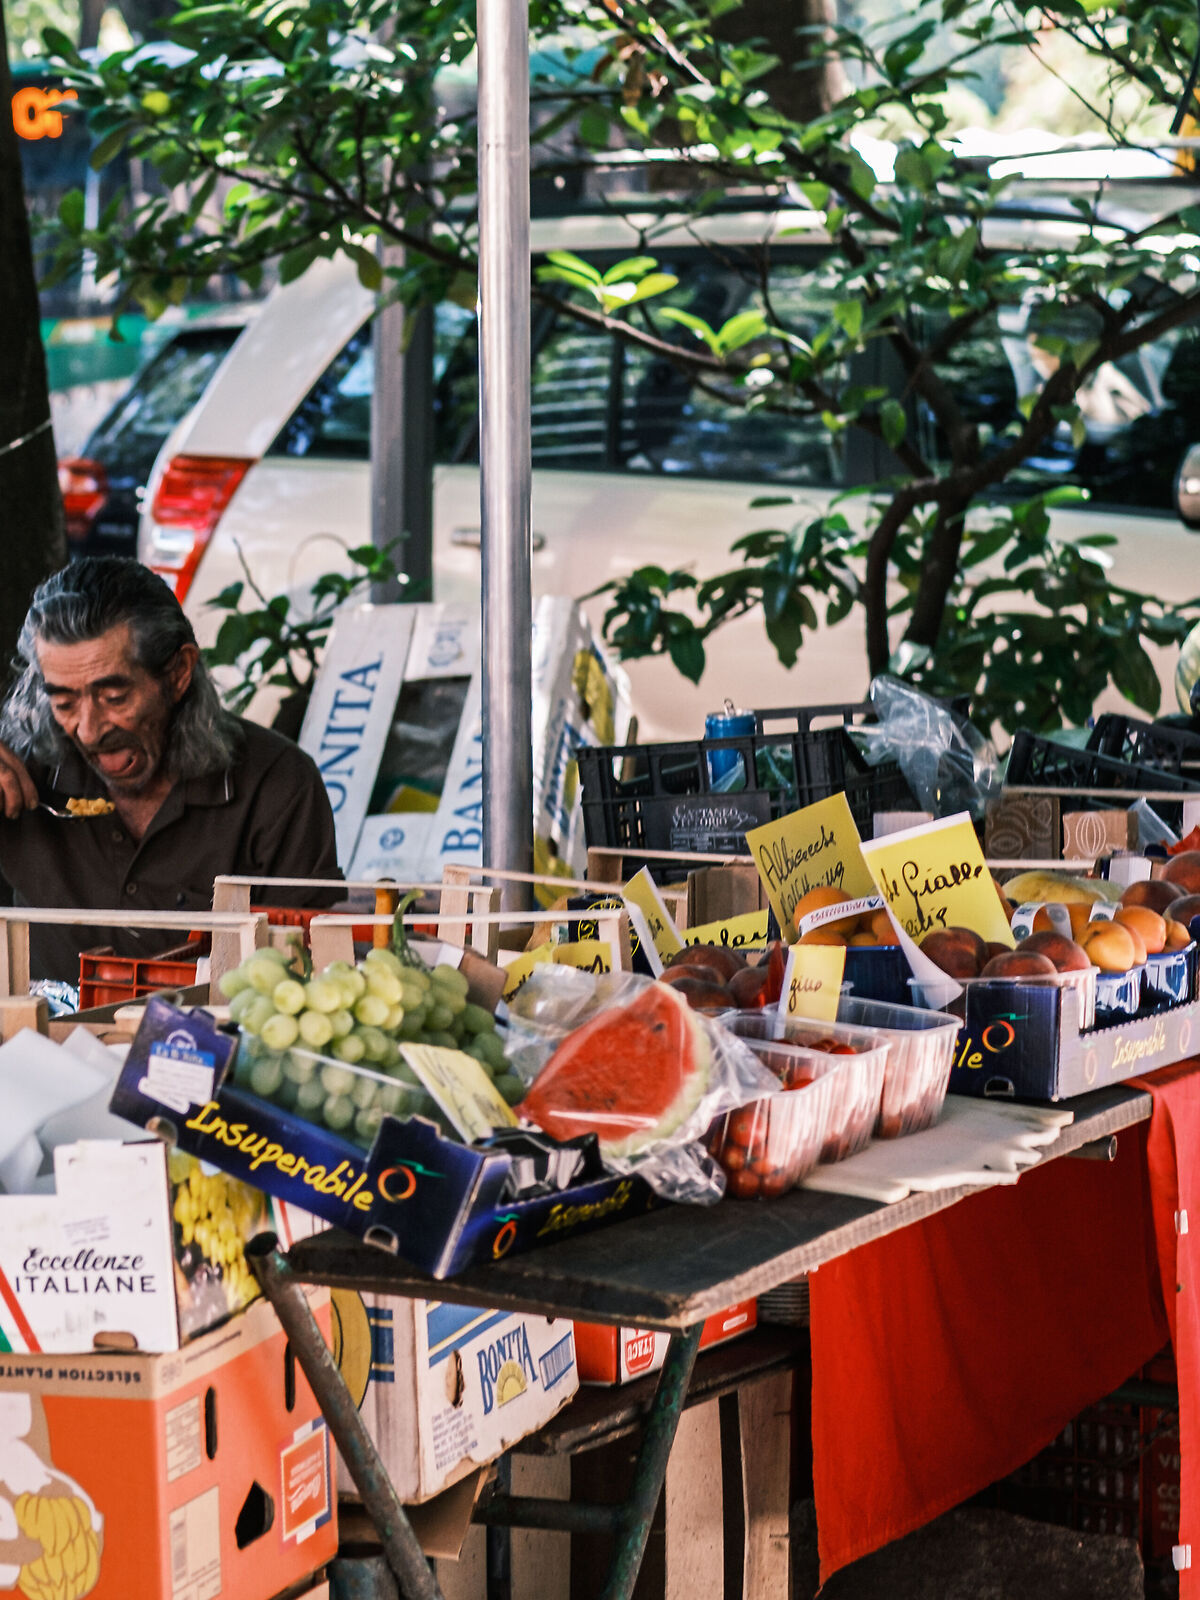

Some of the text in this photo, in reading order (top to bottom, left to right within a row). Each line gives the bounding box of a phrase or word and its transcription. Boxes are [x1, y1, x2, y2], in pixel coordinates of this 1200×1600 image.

[320, 652, 383, 812] ONITA
[185, 1101, 374, 1212] Insuperabile
[15, 1275, 157, 1293] ITALIANE
[22, 1247, 144, 1273] Eccellenze
[56, 1367, 142, 1384] SÉLECTION
[478, 1321, 538, 1415] BONITA
